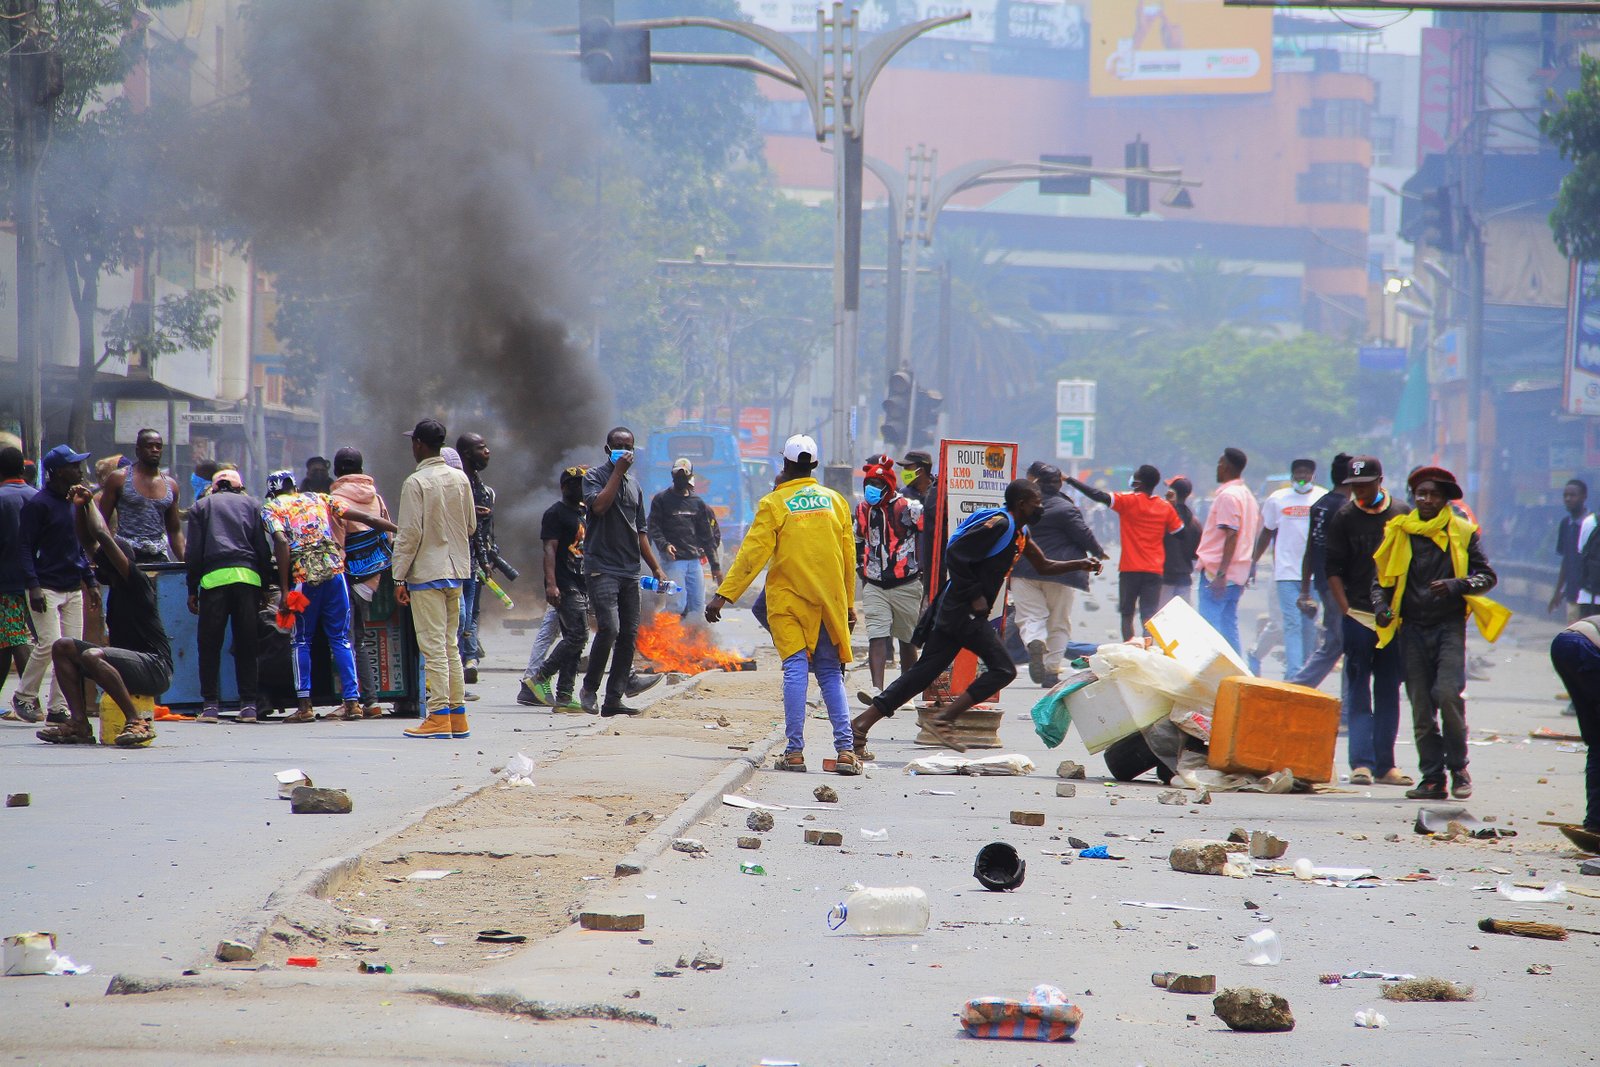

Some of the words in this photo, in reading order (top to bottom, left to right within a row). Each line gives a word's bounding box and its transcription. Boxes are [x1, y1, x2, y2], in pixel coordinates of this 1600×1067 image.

[219, 415, 243, 423] STREET
[957, 450, 985, 466] ROUTE
[953, 467, 971, 478] KMO
[982, 469, 1005, 479] DIGITAL
[950, 478, 975, 490] SACCO
[978, 480, 999, 491] LUXURY
[789, 497, 830, 509] SOKO
